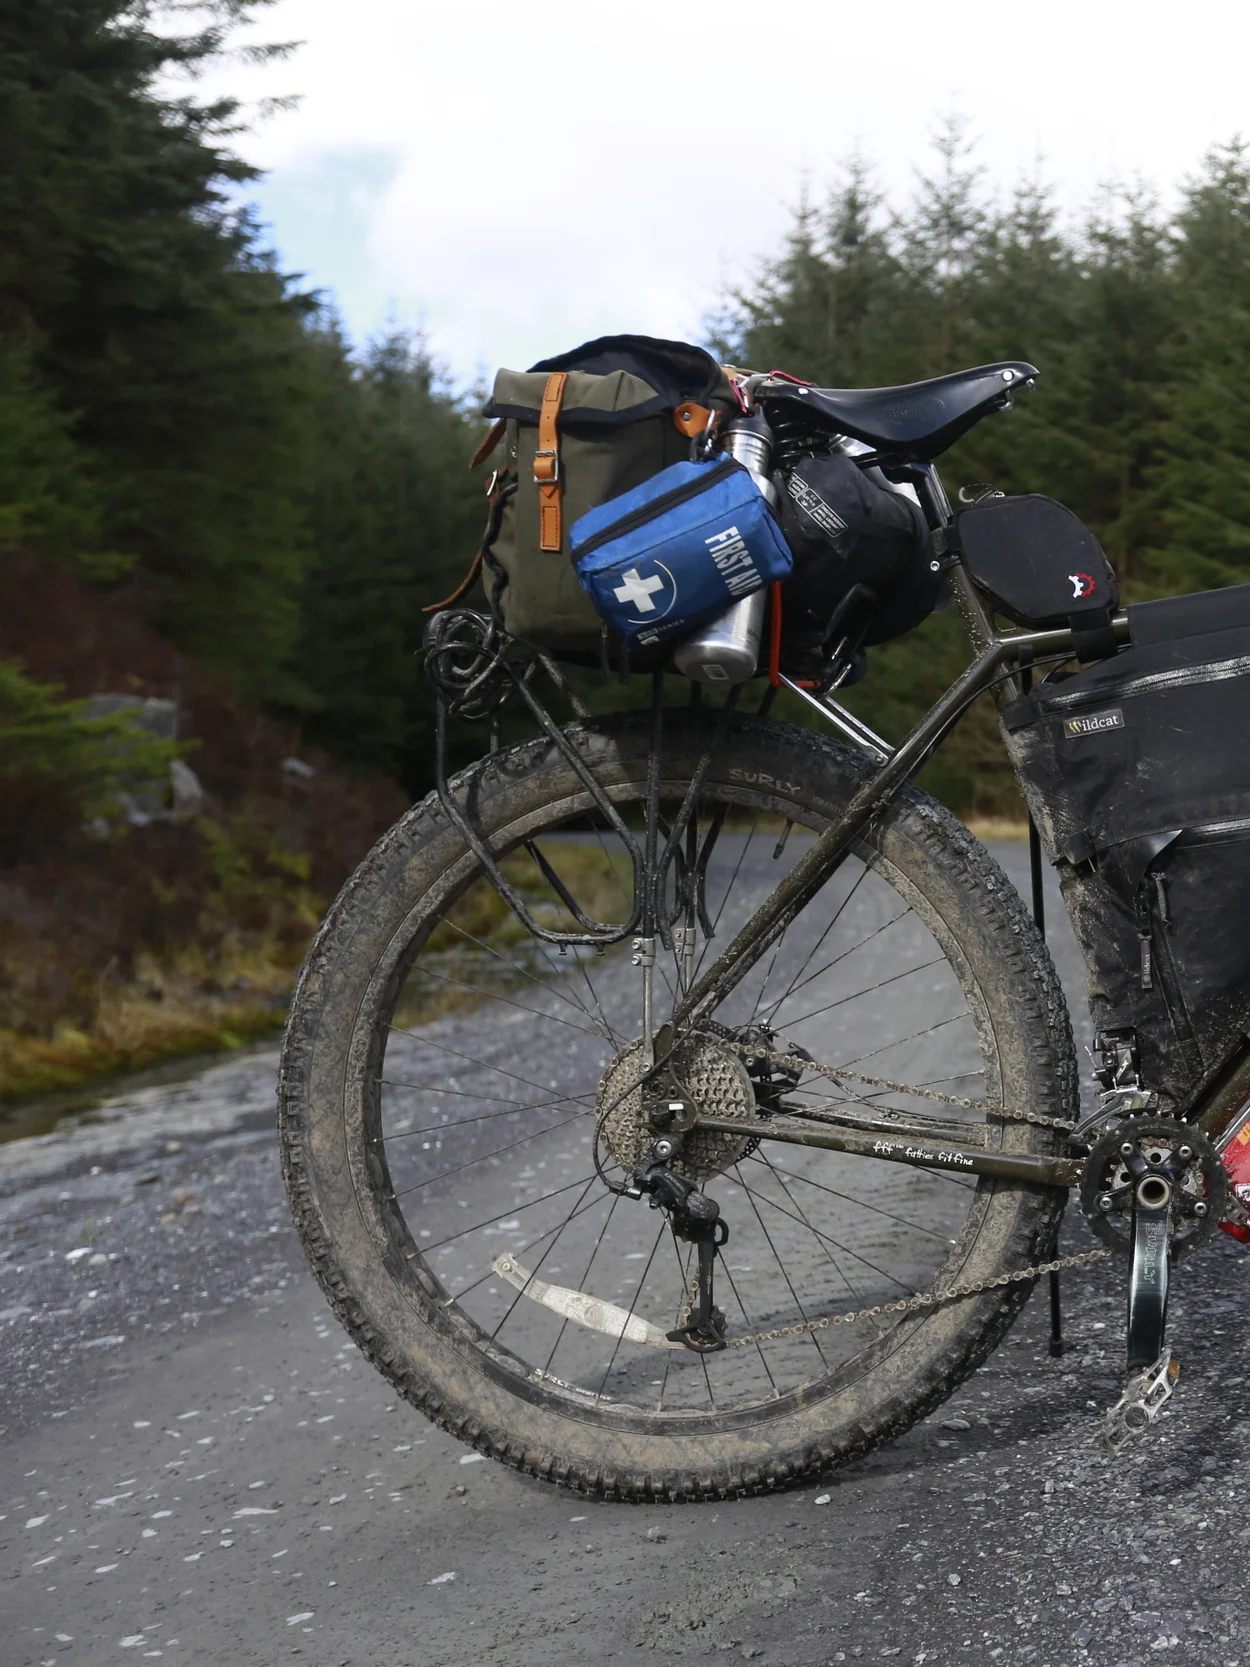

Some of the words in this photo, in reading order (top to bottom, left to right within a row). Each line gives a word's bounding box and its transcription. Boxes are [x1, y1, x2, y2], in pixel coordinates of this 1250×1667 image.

[704, 525, 754, 576] FIRST
[724, 568, 763, 596] AID
[659, 619, 685, 632] SERIES
[1068, 715, 1120, 734] Wildcat
[728, 768, 801, 795] SURLY
[904, 1147, 934, 1160] fatties
[938, 1151, 953, 1162] fit
[953, 1153, 974, 1166] fine
[1144, 1223, 1158, 1285] SURLY
